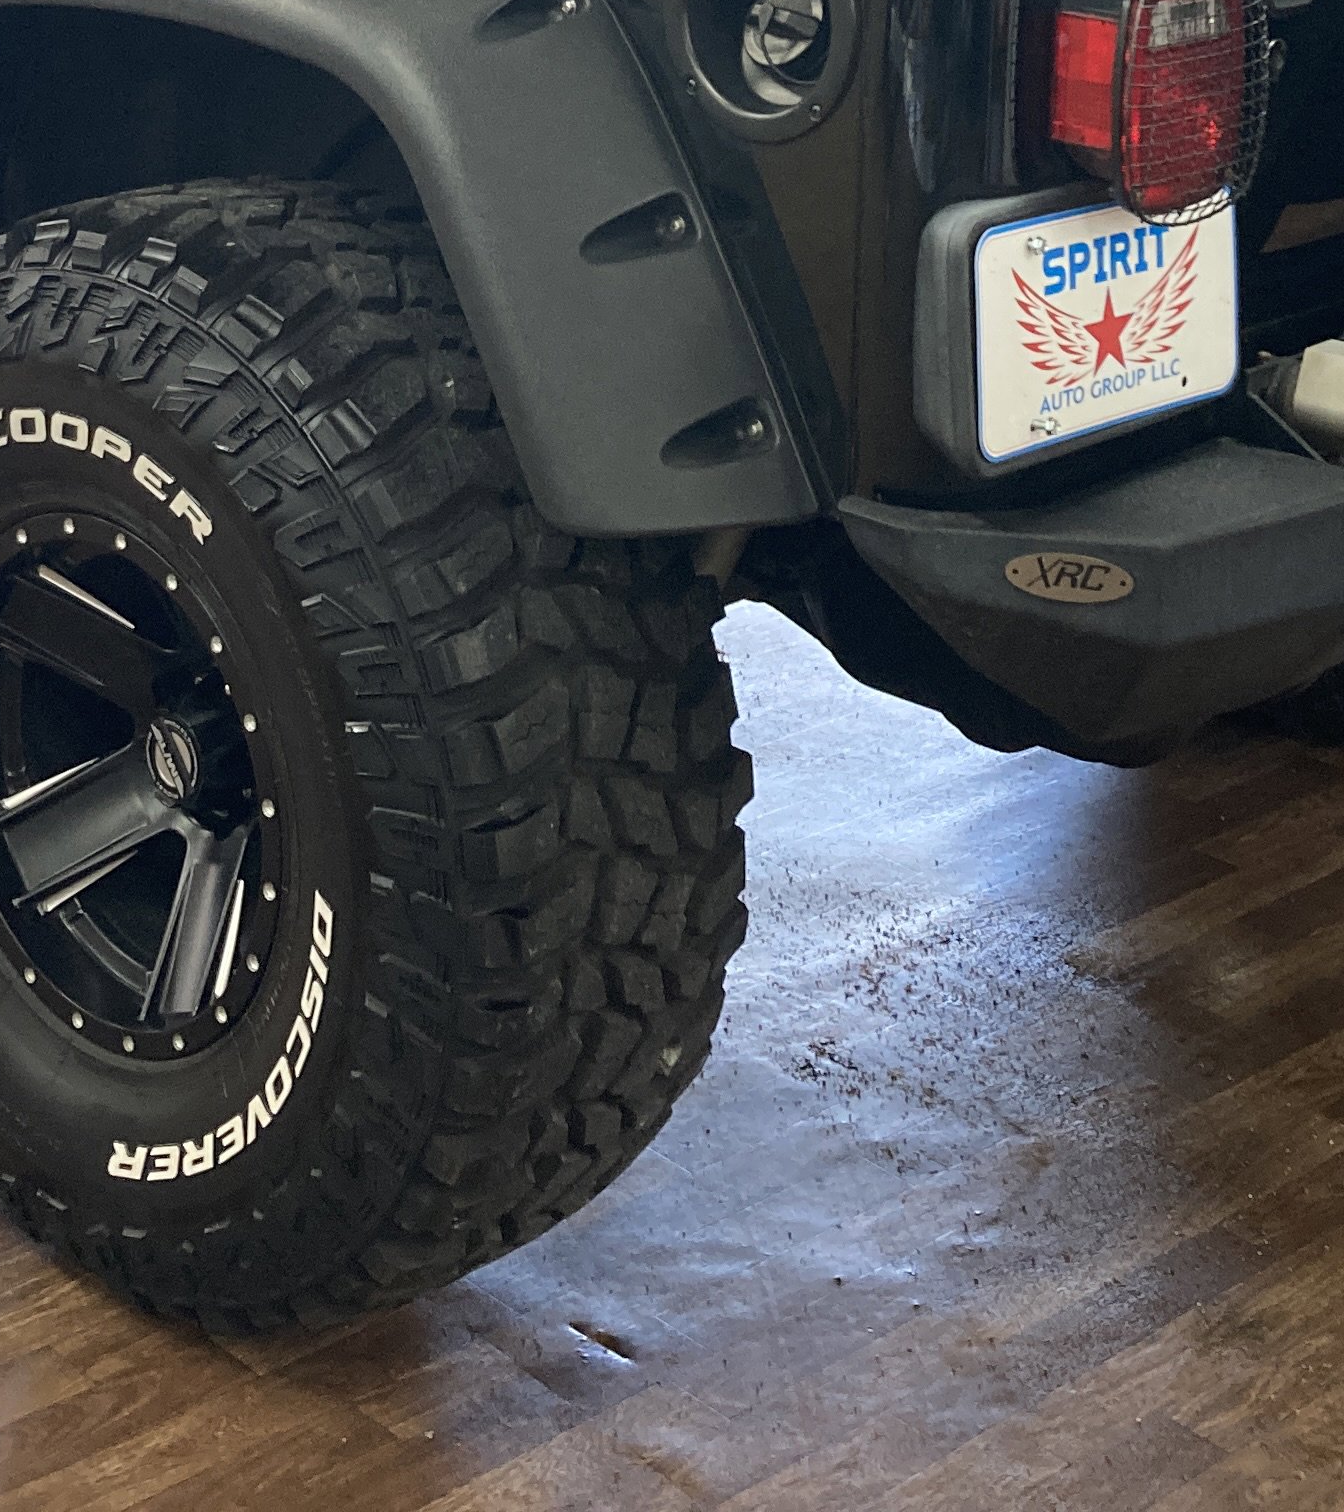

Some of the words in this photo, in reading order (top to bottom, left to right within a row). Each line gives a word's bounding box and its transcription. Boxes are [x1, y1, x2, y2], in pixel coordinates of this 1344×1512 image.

[1042, 225, 1170, 296] SPIRIT
[1039, 386, 1086, 414] AUTO
[1090, 368, 1147, 400] GROUP
[1151, 358, 1182, 382] LLC
[1027, 556, 1112, 592] XRC
[106, 889, 334, 1182] DISCOVERER
